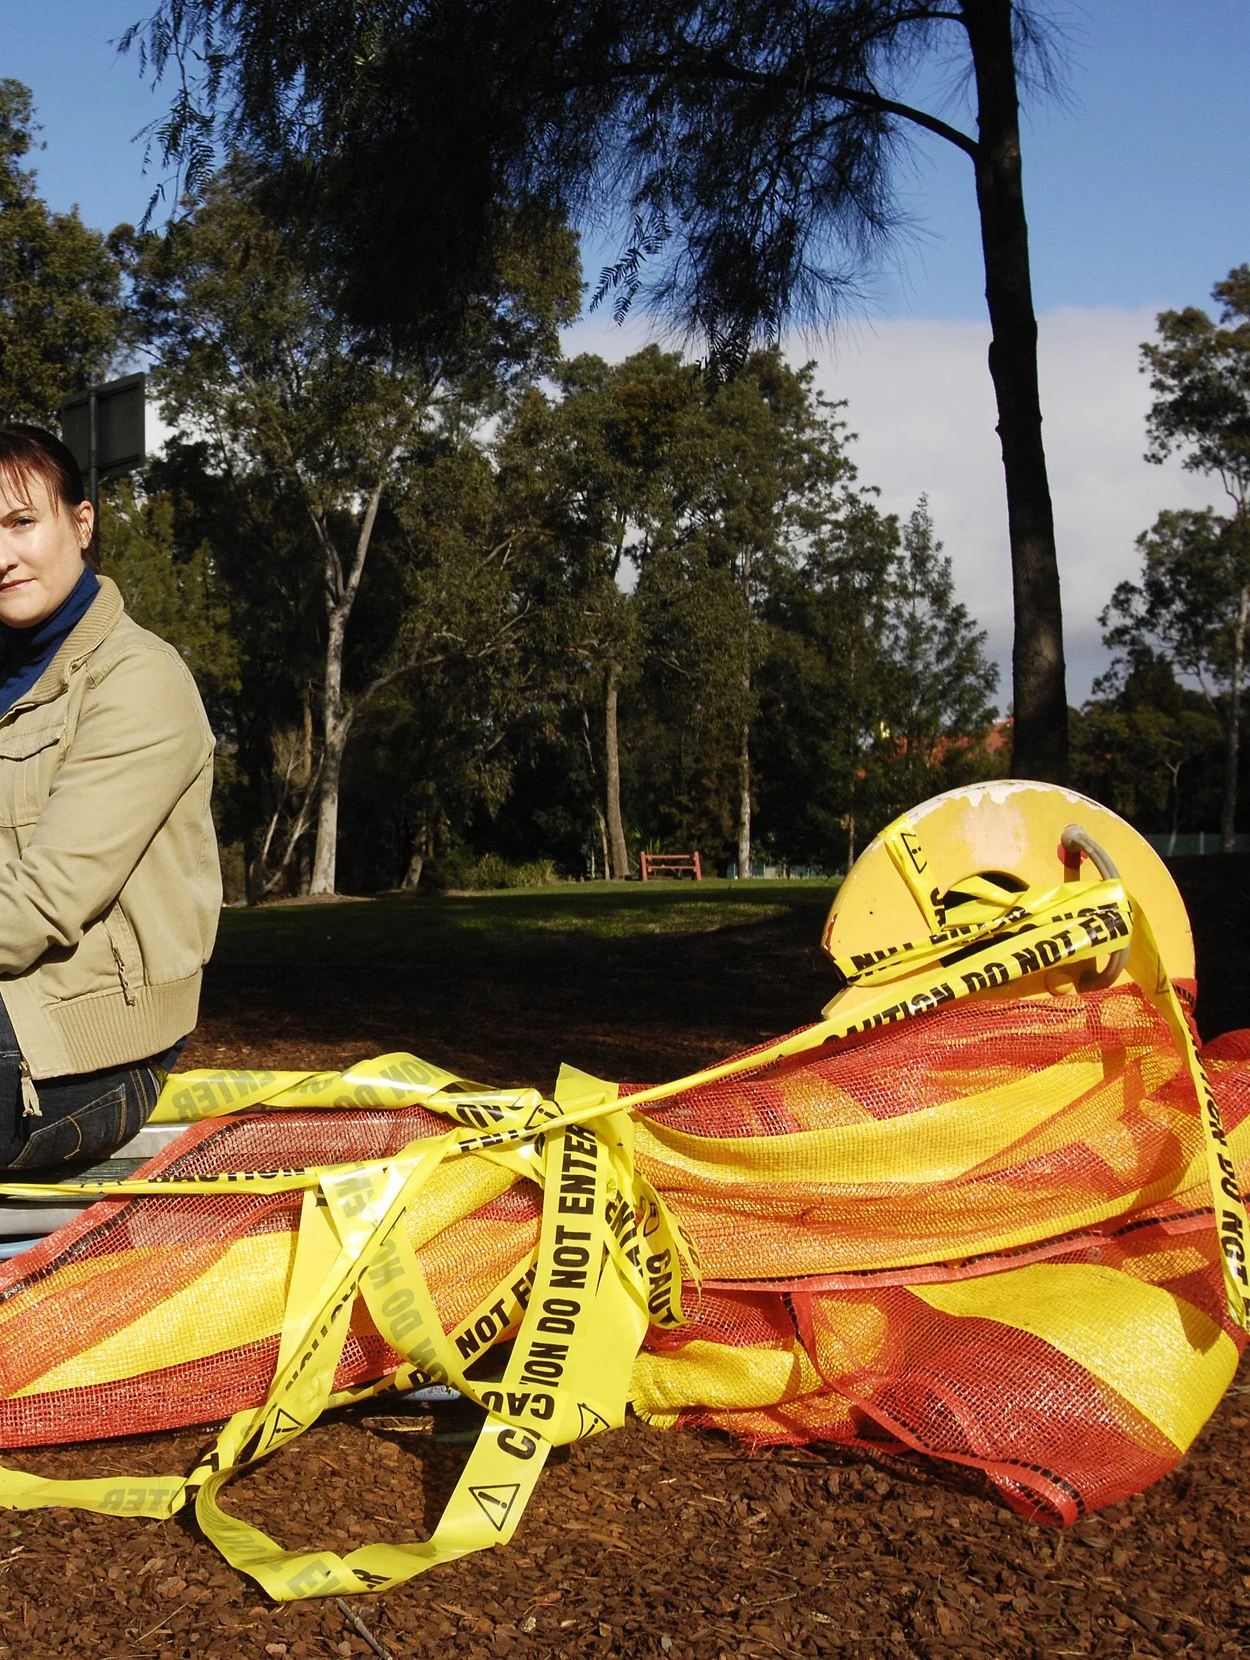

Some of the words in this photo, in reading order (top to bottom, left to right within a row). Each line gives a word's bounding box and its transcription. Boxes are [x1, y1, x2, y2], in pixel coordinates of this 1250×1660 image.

[960, 962, 1010, 993] DO
[1012, 929, 1077, 975] NOT
[558, 1123, 598, 1216] ENTER
[549, 1225, 591, 1289] NOT
[645, 1248, 680, 1326] CAUT
[455, 1298, 511, 1360] NOT
[536, 1298, 581, 1336] DO
